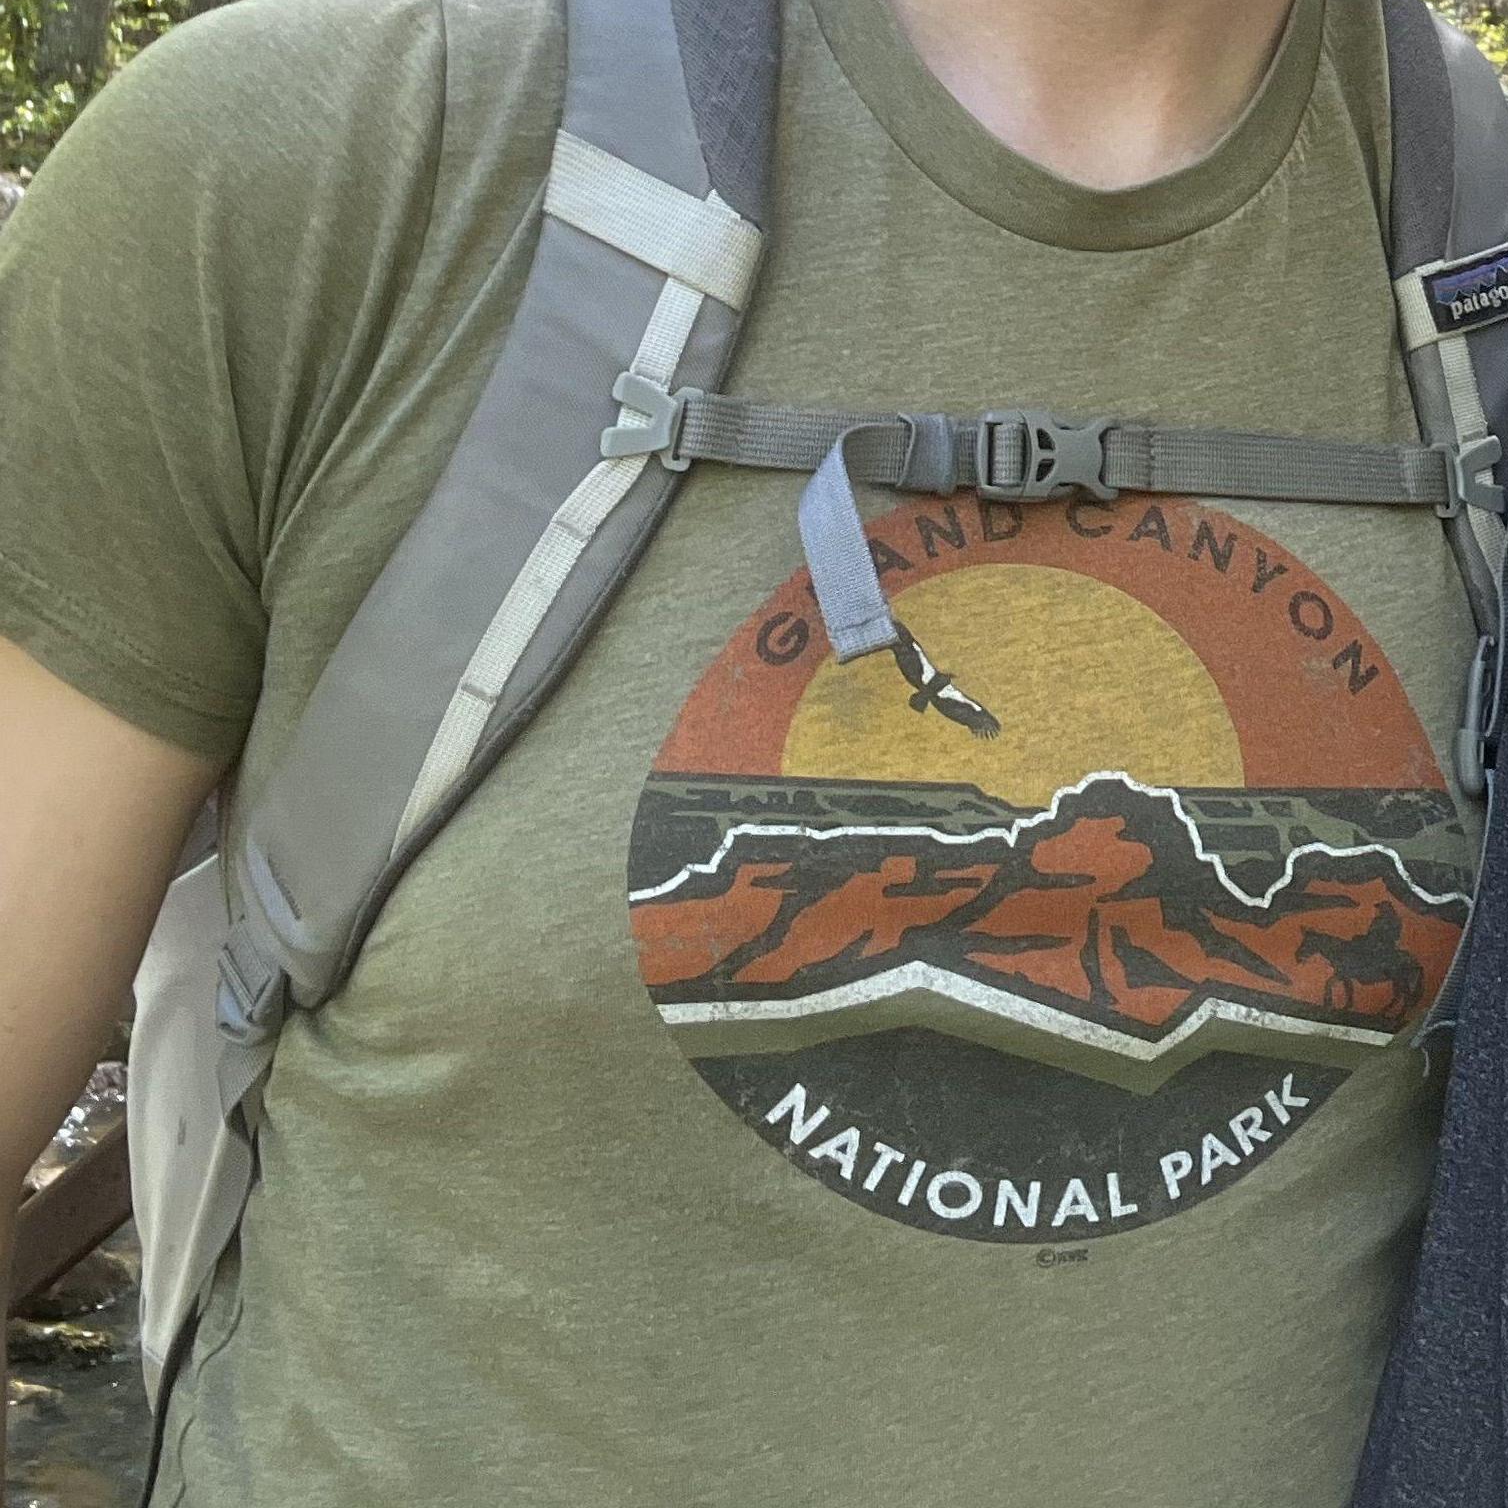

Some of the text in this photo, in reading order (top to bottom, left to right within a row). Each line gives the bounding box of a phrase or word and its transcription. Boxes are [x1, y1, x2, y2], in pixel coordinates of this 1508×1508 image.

[756, 498, 1380, 694] GAND CANYON
[764, 1073, 1310, 1229] NATIONAL PARK
